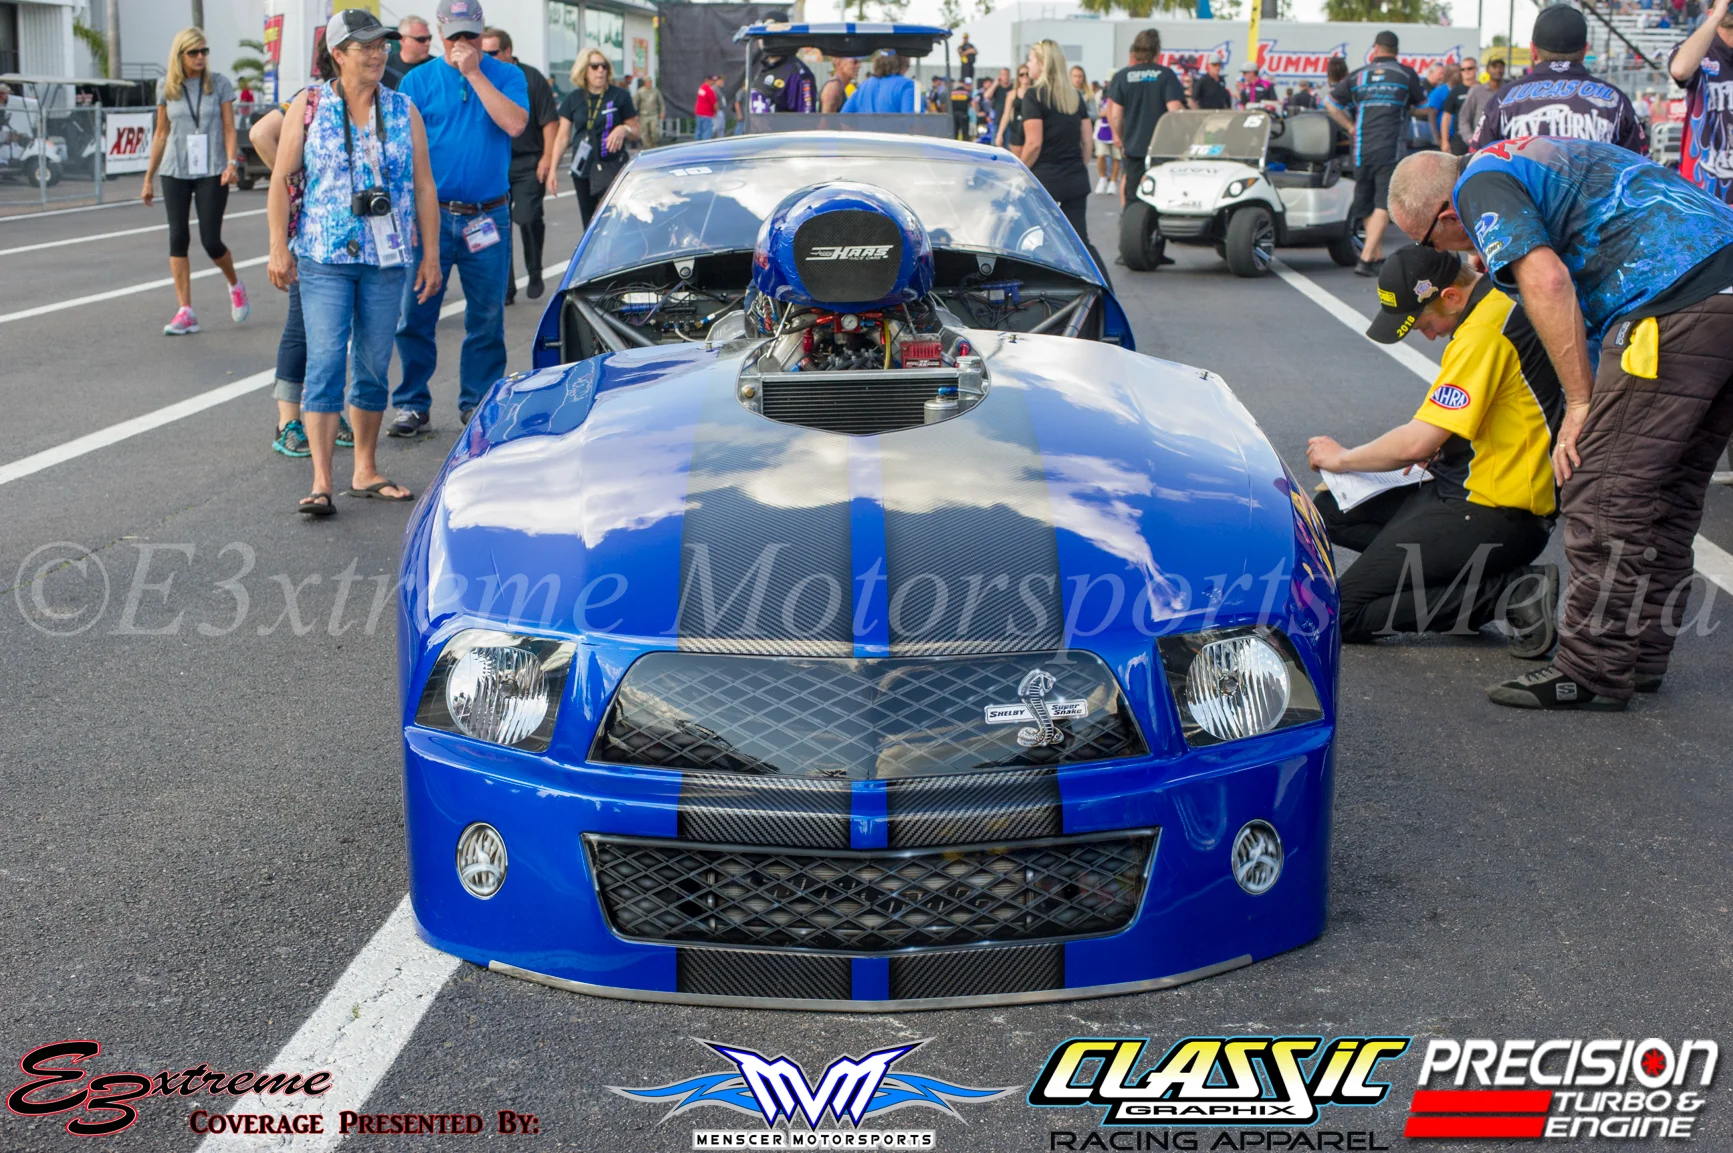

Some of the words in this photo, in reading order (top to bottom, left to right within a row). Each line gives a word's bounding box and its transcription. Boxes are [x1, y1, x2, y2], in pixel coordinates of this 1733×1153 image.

[1256, 43, 1339, 73] SUMMI
[1502, 80, 1579, 105] LUCAS
[1580, 81, 1613, 101] OIL
[110, 127, 145, 155] XRP
[829, 245, 894, 260] HAAS
[1396, 315, 1416, 338] 2018
[1431, 385, 1467, 409] NHRA
[989, 709, 1025, 718] SHELBY
[1051, 703, 1080, 711] Super
